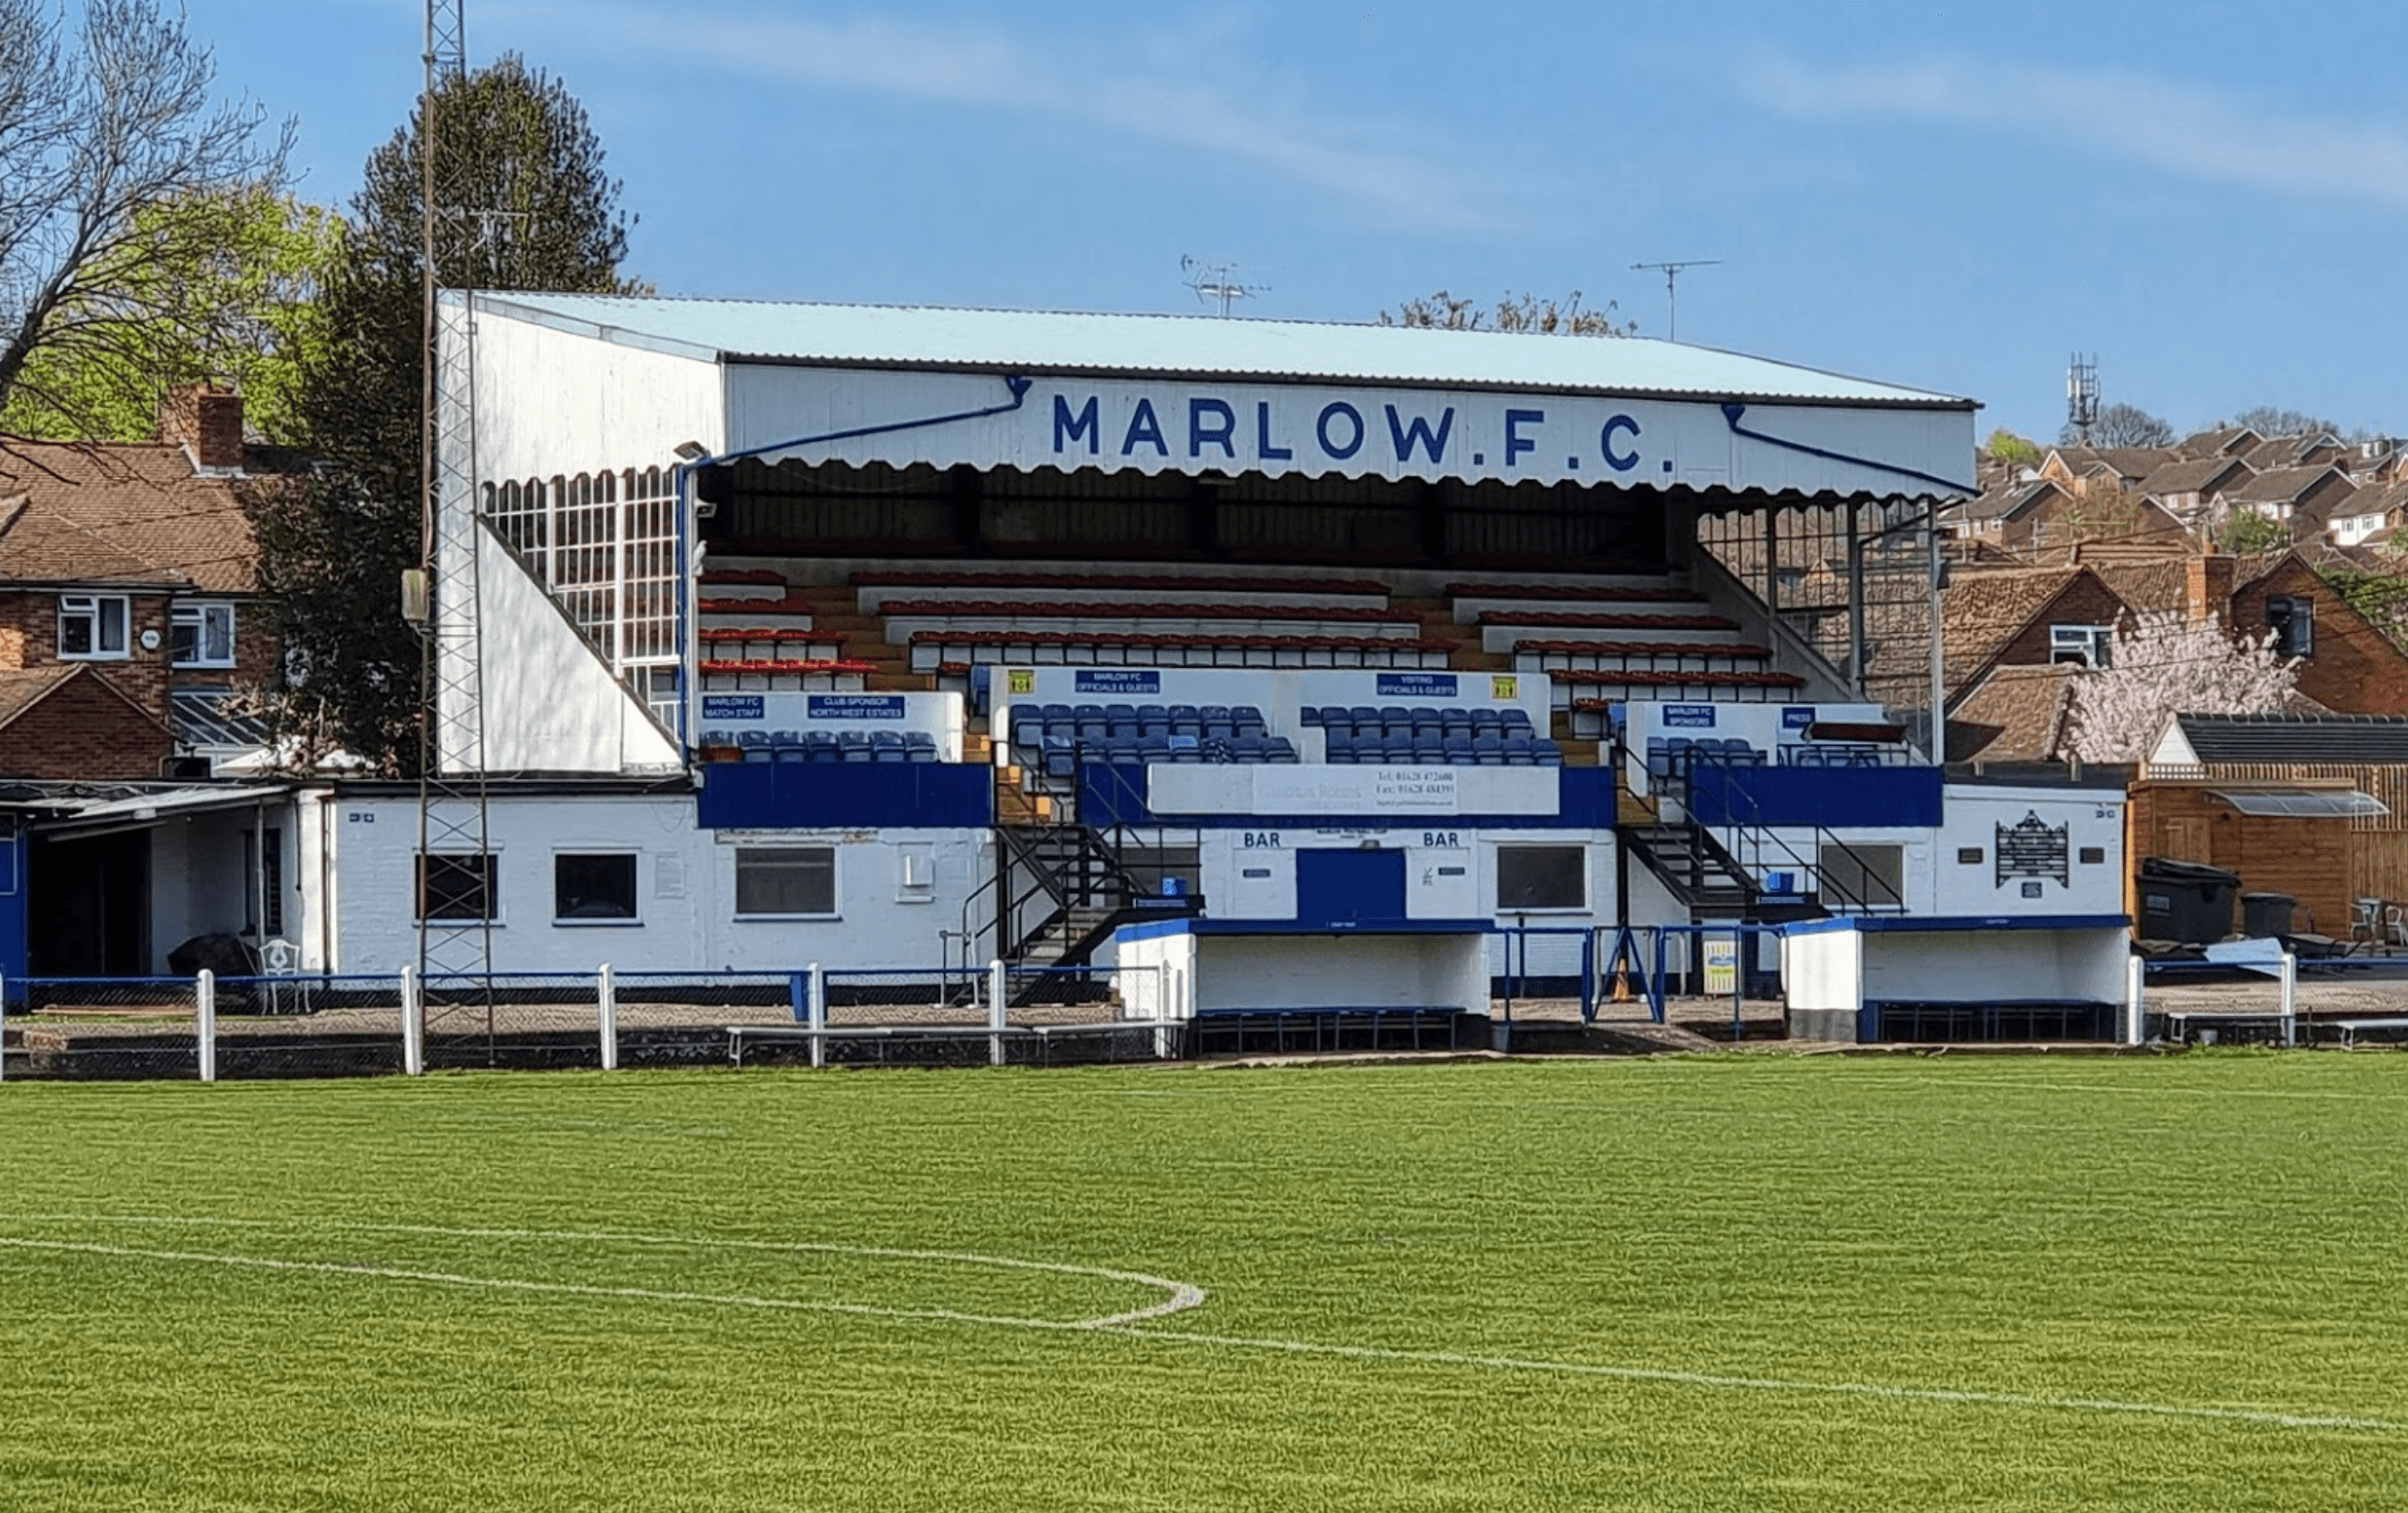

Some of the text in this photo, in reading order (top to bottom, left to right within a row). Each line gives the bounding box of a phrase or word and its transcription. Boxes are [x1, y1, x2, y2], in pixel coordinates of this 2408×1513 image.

[1093, 672, 1142, 682] MARLOW FC
[1076, 683, 1117, 691] OFFICIALS
[1378, 684, 1417, 694] OFFICIALS
[708, 697, 759, 706] MARLOW FC
[823, 697, 890, 706] CLUB SPONSOR
[705, 708, 761, 718] MATCH STAFF
[810, 708, 902, 717] NORTH WEST ESTATES
[1244, 831, 1281, 848] BAR
[1423, 832, 1459, 847] BAR
